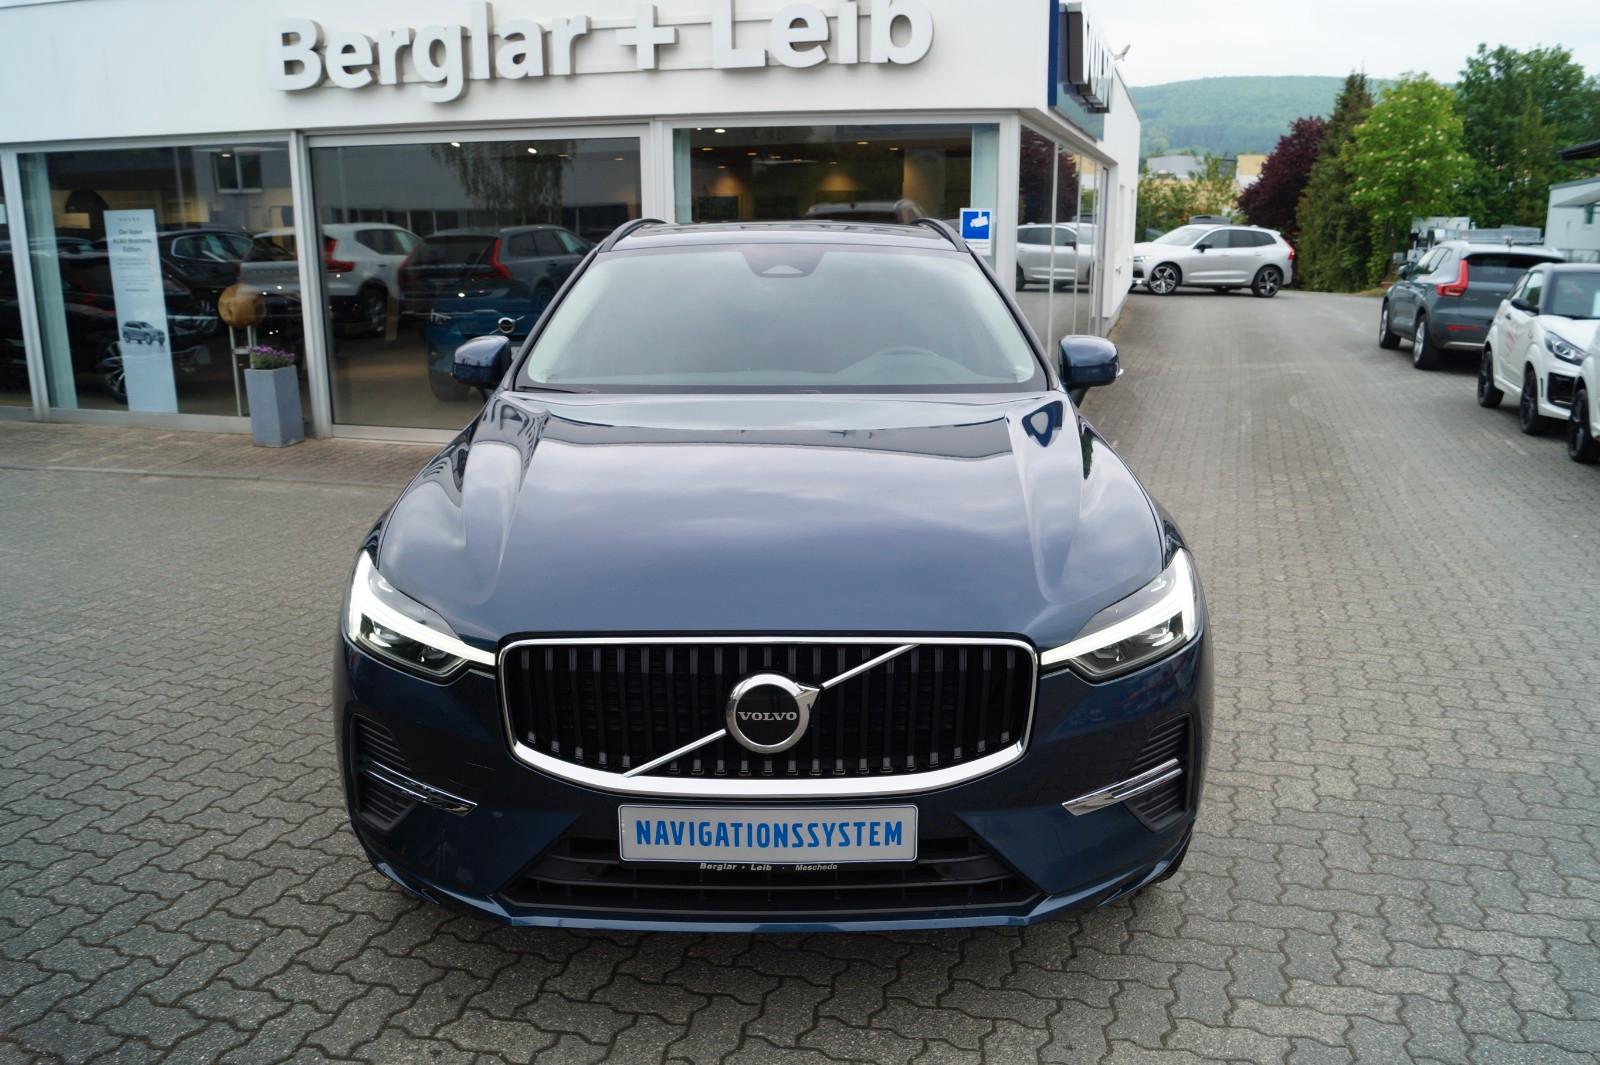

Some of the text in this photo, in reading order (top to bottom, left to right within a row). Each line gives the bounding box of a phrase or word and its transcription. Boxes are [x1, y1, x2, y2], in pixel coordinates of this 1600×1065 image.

[271, 0, 935, 104] Berglar + Leib
[738, 711, 798, 721] VOLVO
[635, 820, 903, 848] NAVIGATIONSSYSTEM
[699, 862, 737, 871] Berglar
[750, 863, 772, 871] Leib
